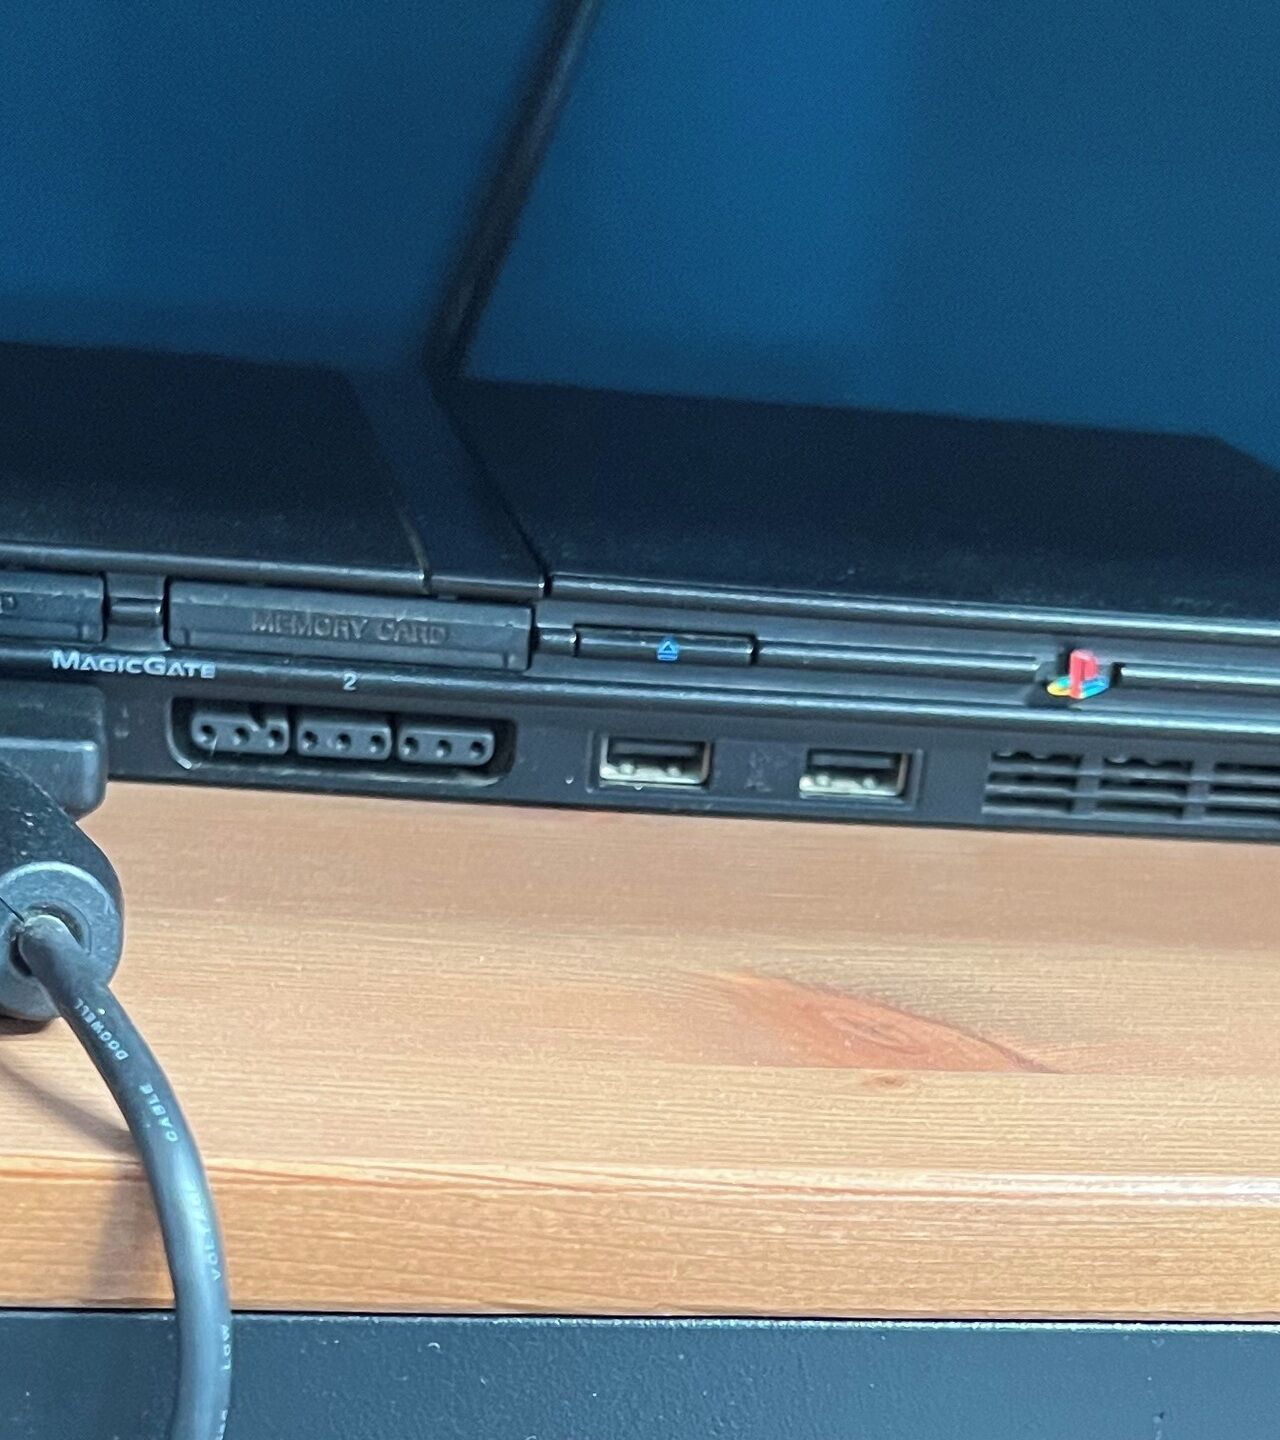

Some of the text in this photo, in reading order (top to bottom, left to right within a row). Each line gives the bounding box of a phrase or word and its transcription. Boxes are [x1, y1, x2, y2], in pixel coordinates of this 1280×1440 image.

[251, 610, 448, 645] MEMORY CARD
[343, 671, 358, 691] 2
[139, 1083, 179, 1142] CABLE
